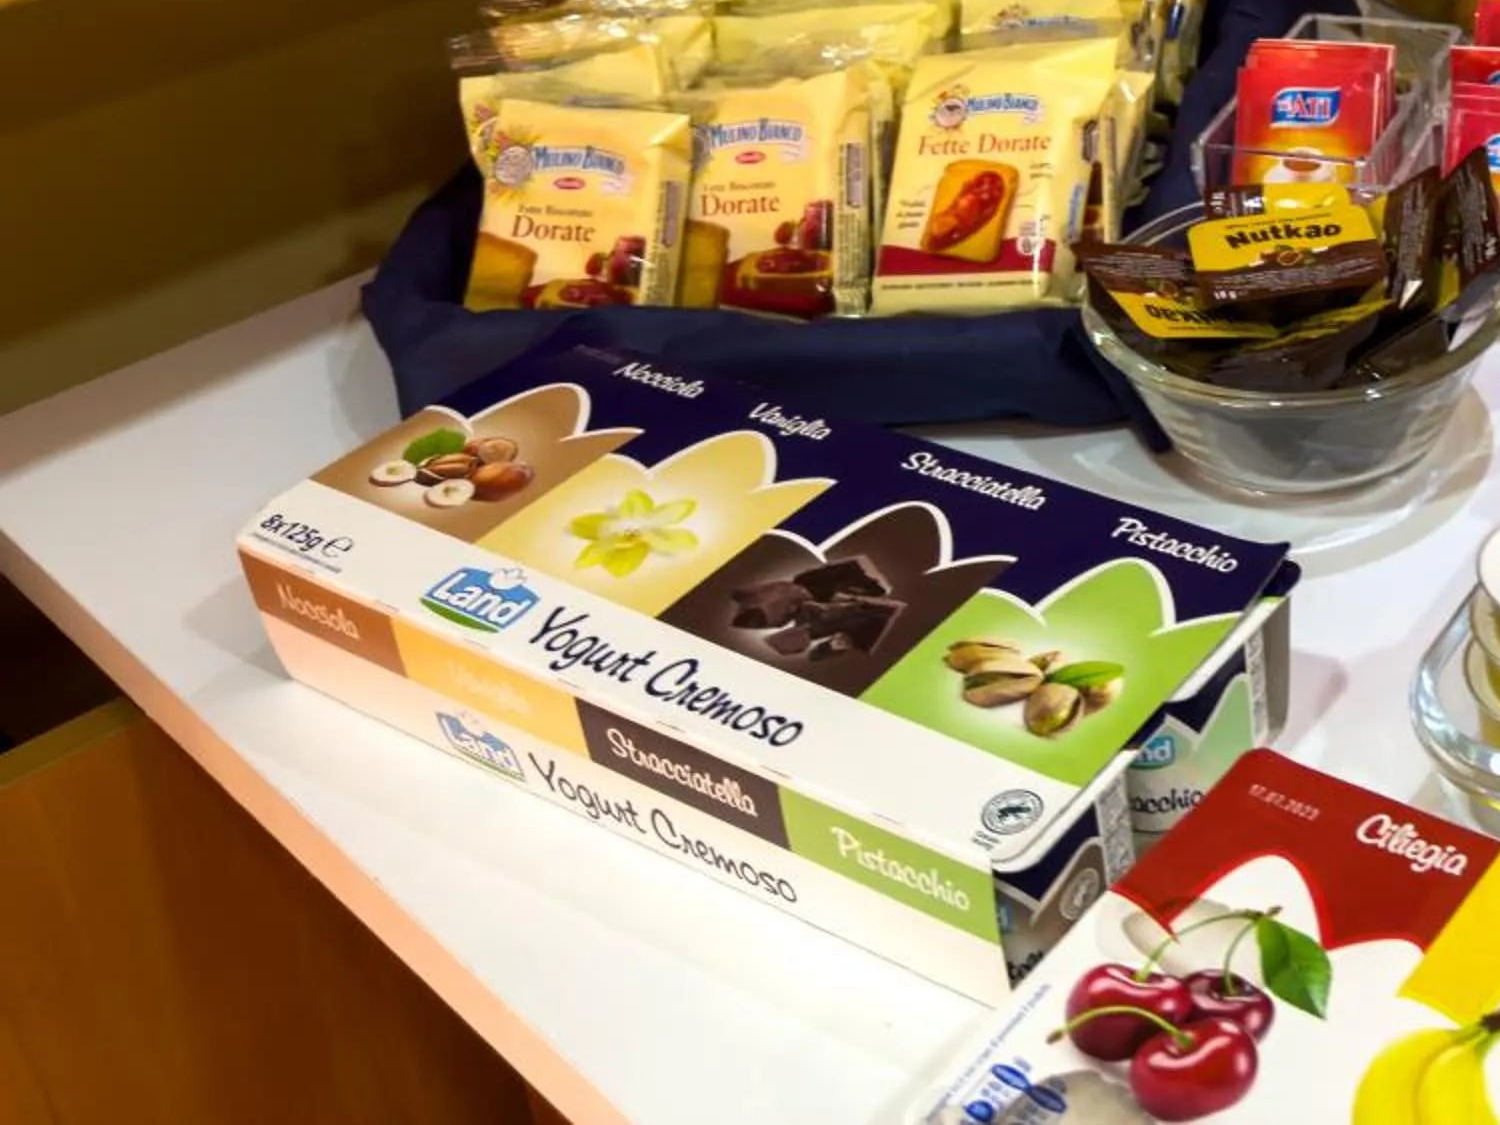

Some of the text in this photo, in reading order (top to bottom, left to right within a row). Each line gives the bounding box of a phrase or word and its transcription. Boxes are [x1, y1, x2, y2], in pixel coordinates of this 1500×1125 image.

[918, 133, 1052, 156] Fette Dorate
[511, 215, 597, 243] Dorate
[701, 194, 780, 217] Dorate
[1225, 223, 1342, 249] Nutkao
[611, 362, 705, 399] Nocciola
[747, 401, 833, 442] Vaniglia
[900, 450, 1047, 512] Stracciatella
[1110, 516, 1239, 574] Pistacchio
[433, 572, 531, 625] Land
[527, 605, 805, 748] Yogurt Cremoso
[606, 727, 758, 817] Stracciatella
[528, 751, 799, 905] Yogurt Cremoso
[1356, 813, 1469, 876] Ciliegia
[829, 825, 971, 913] Pistacchio
